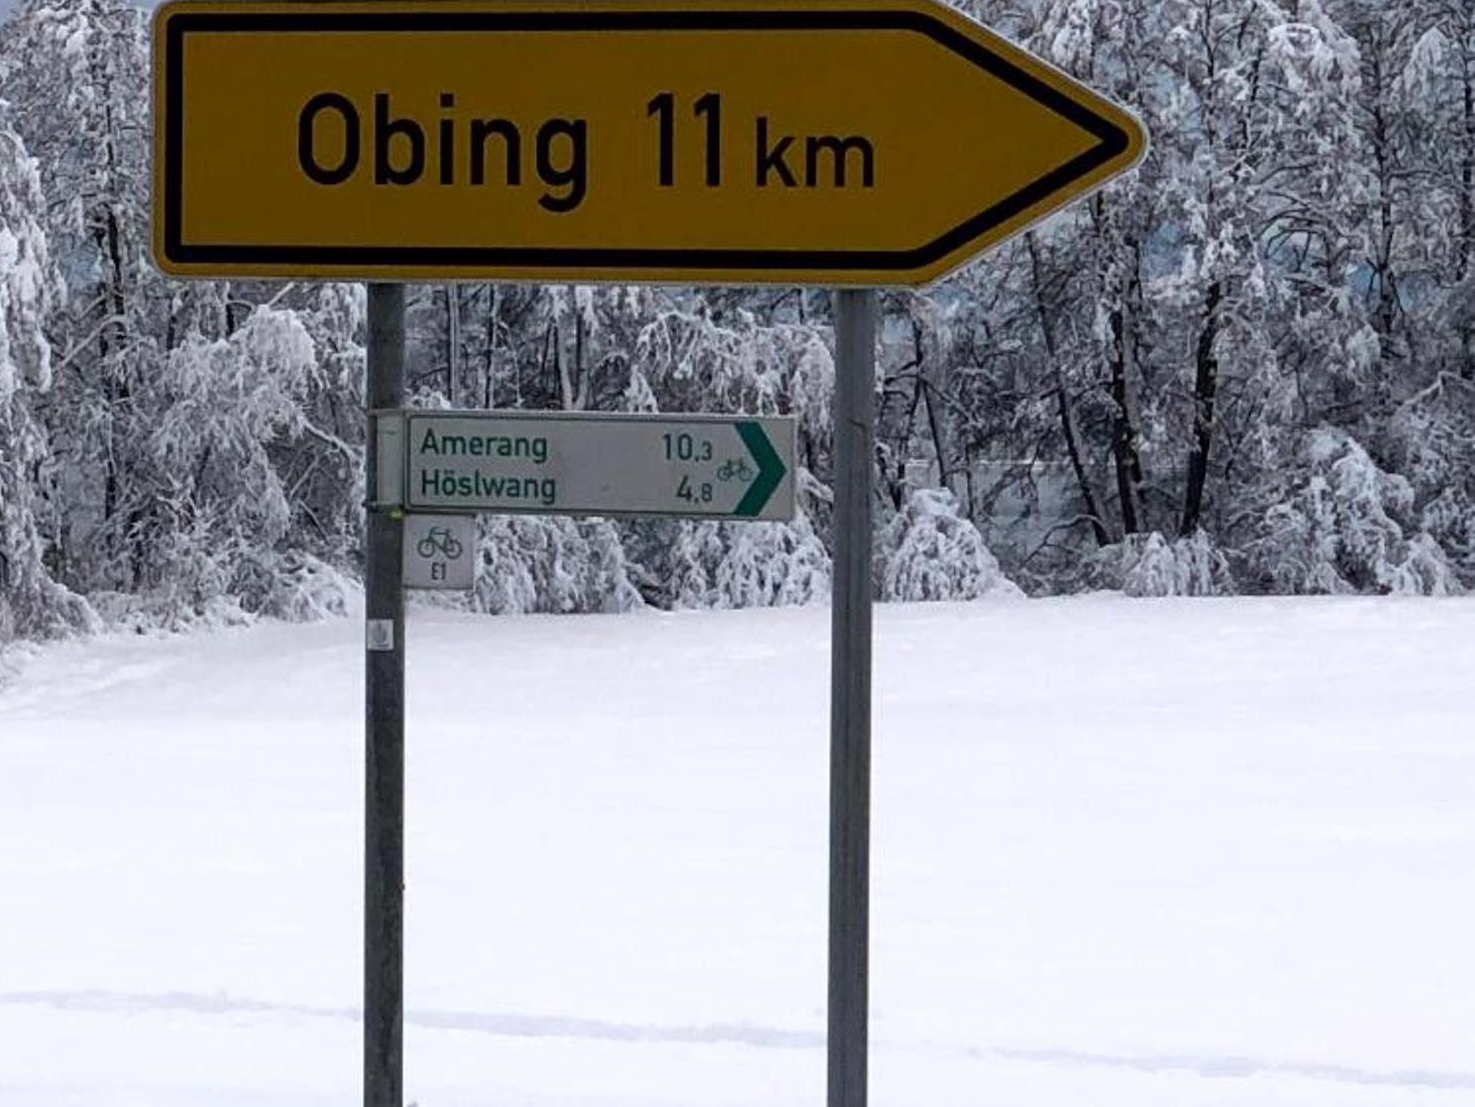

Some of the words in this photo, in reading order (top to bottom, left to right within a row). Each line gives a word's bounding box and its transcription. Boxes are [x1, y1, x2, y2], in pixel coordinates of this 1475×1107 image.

[297, 93, 589, 213] Obing
[647, 93, 722, 186] 11
[756, 117, 876, 187] km
[420, 428, 547, 464] Amerang
[421, 470, 556, 505] Höslwang
